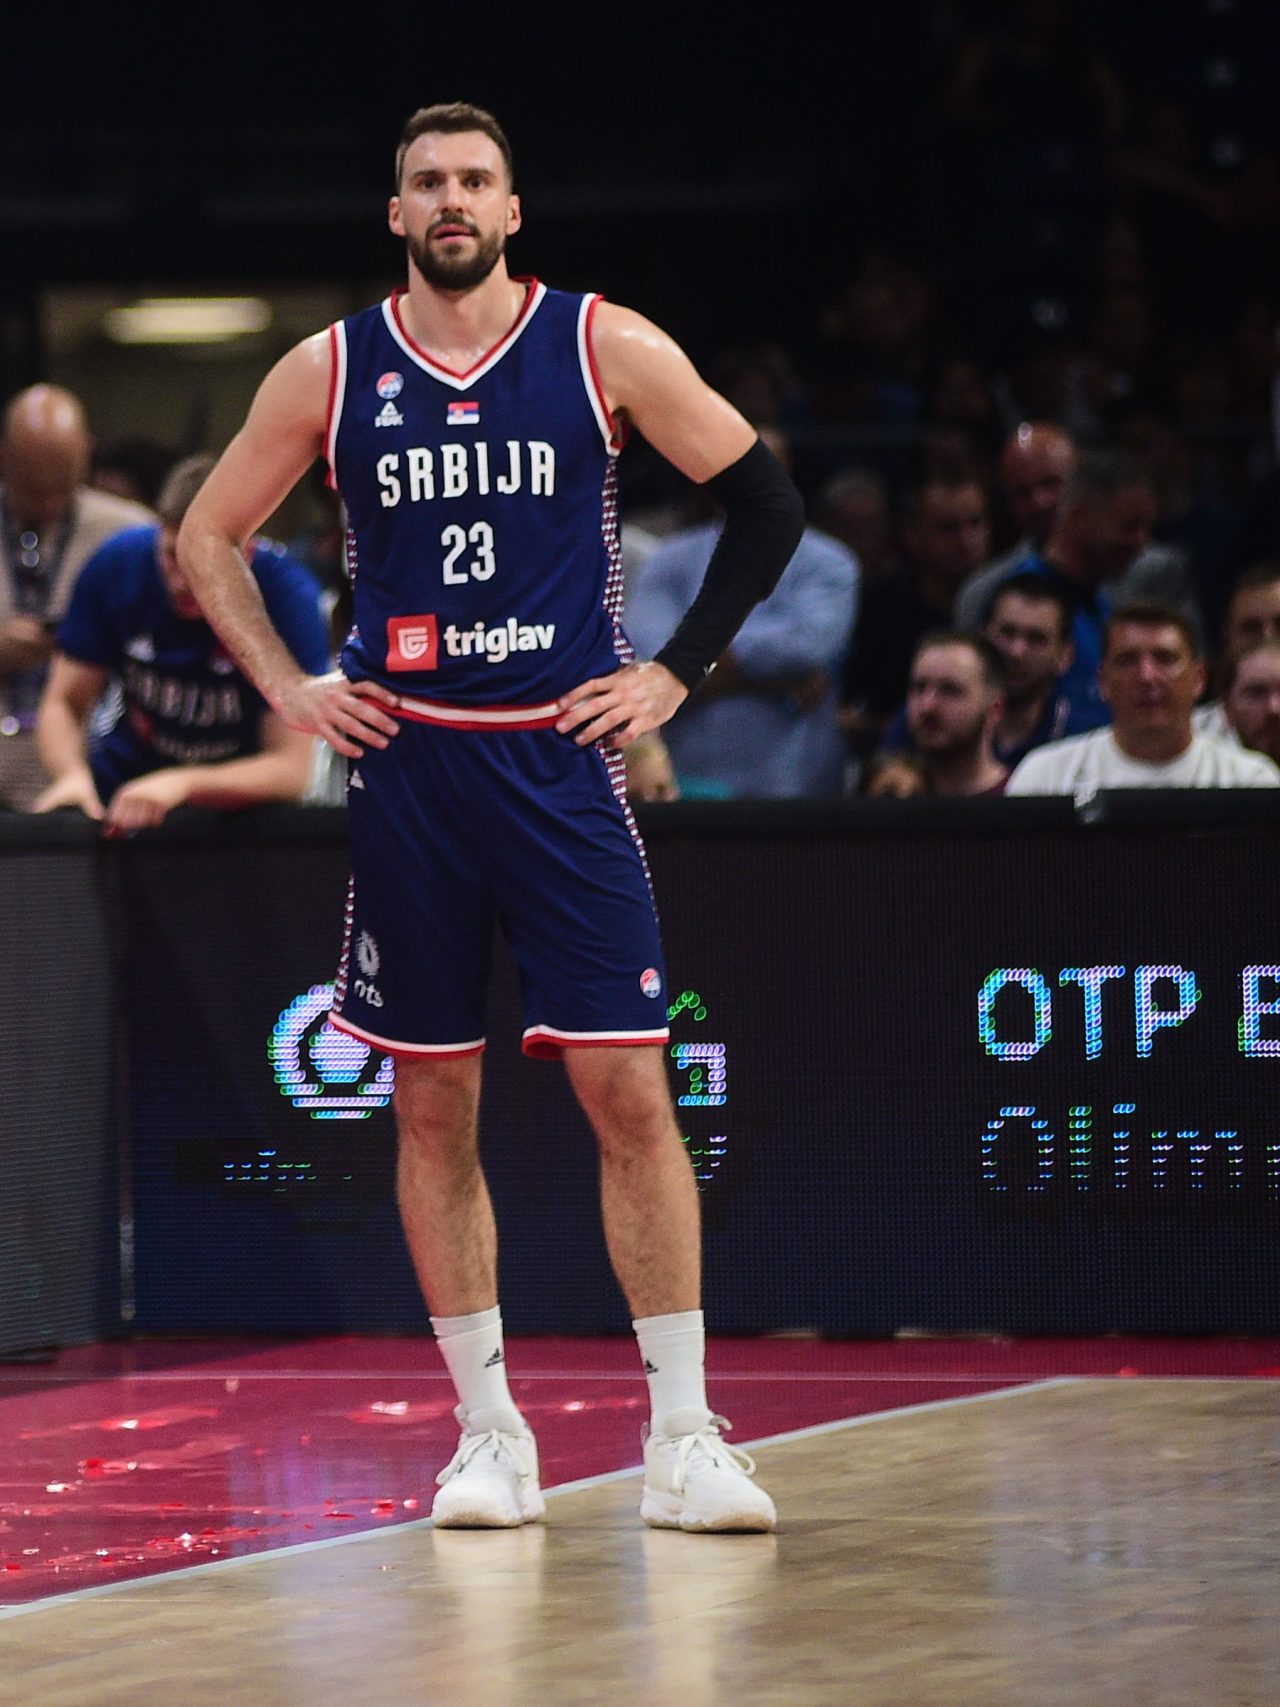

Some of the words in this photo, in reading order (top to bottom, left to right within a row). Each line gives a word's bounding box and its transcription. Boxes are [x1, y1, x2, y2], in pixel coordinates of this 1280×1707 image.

[376, 440, 556, 508] SRBIJA
[440, 521, 496, 585] 23
[443, 617, 556, 663] triglav
[354, 980, 384, 1008] nts
[977, 965, 1202, 1060] OTP
[980, 1102, 1280, 1201] Olim
